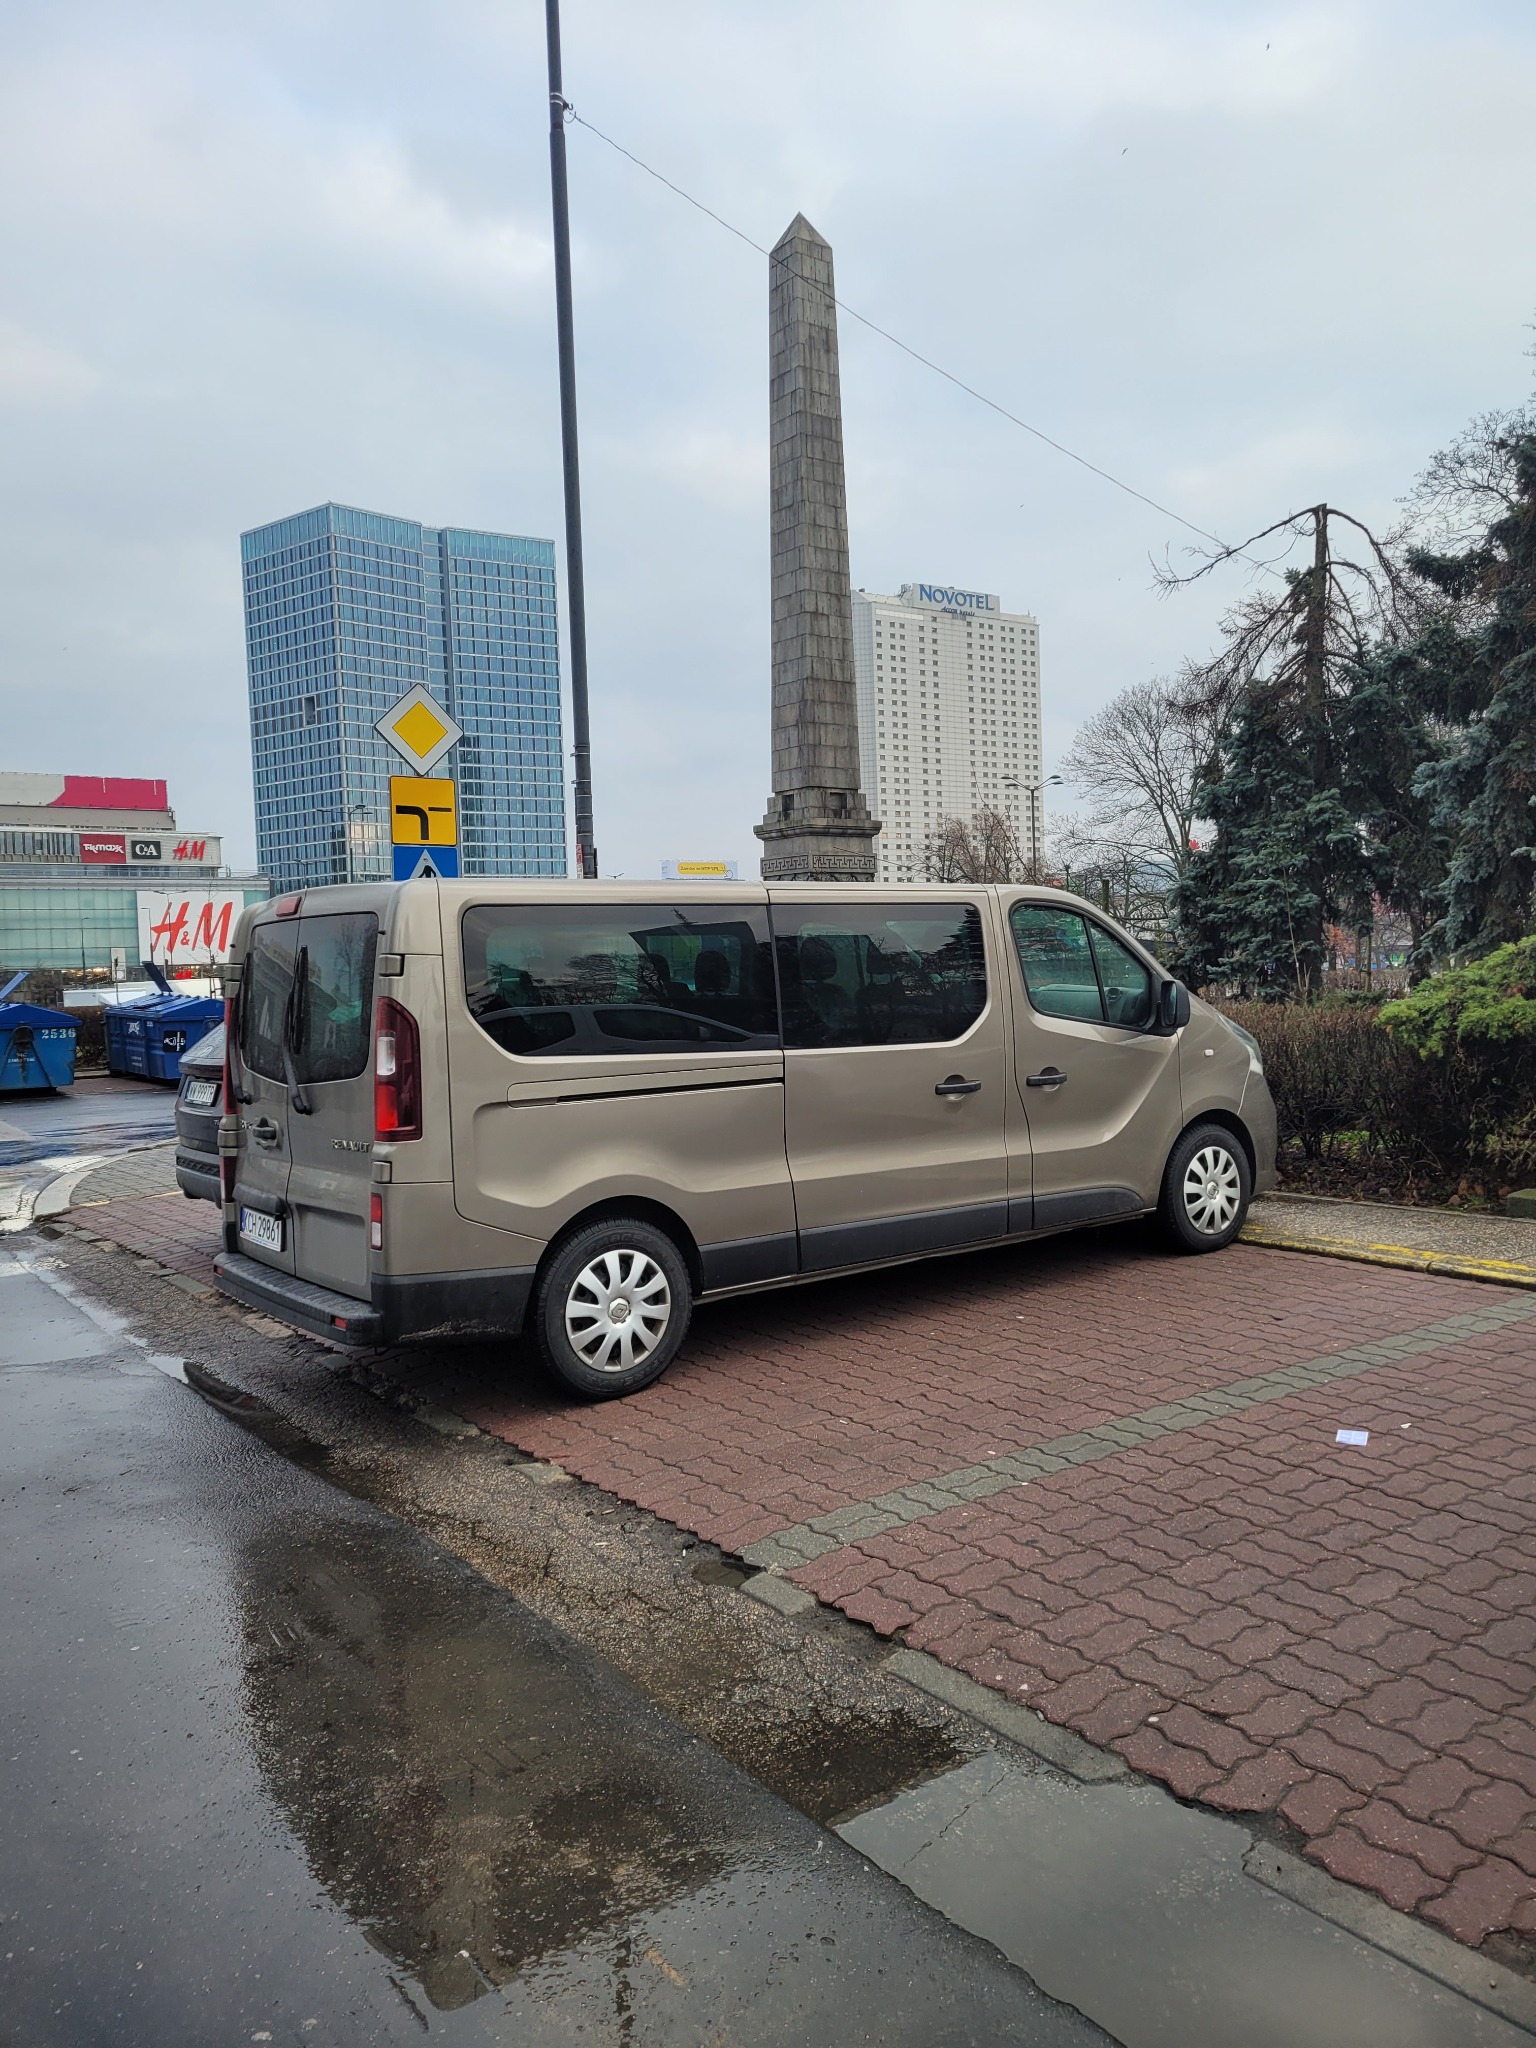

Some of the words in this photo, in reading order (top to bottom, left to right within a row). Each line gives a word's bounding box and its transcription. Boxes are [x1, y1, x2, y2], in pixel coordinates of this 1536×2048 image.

[919, 584, 995, 610] NOVOTEL
[135, 843, 159, 856] C&A
[173, 840, 206, 861] H&M
[150, 901, 233, 953] H&M
[41, 1028, 77, 1039] 2536
[257, 1215, 280, 1244] 29861
